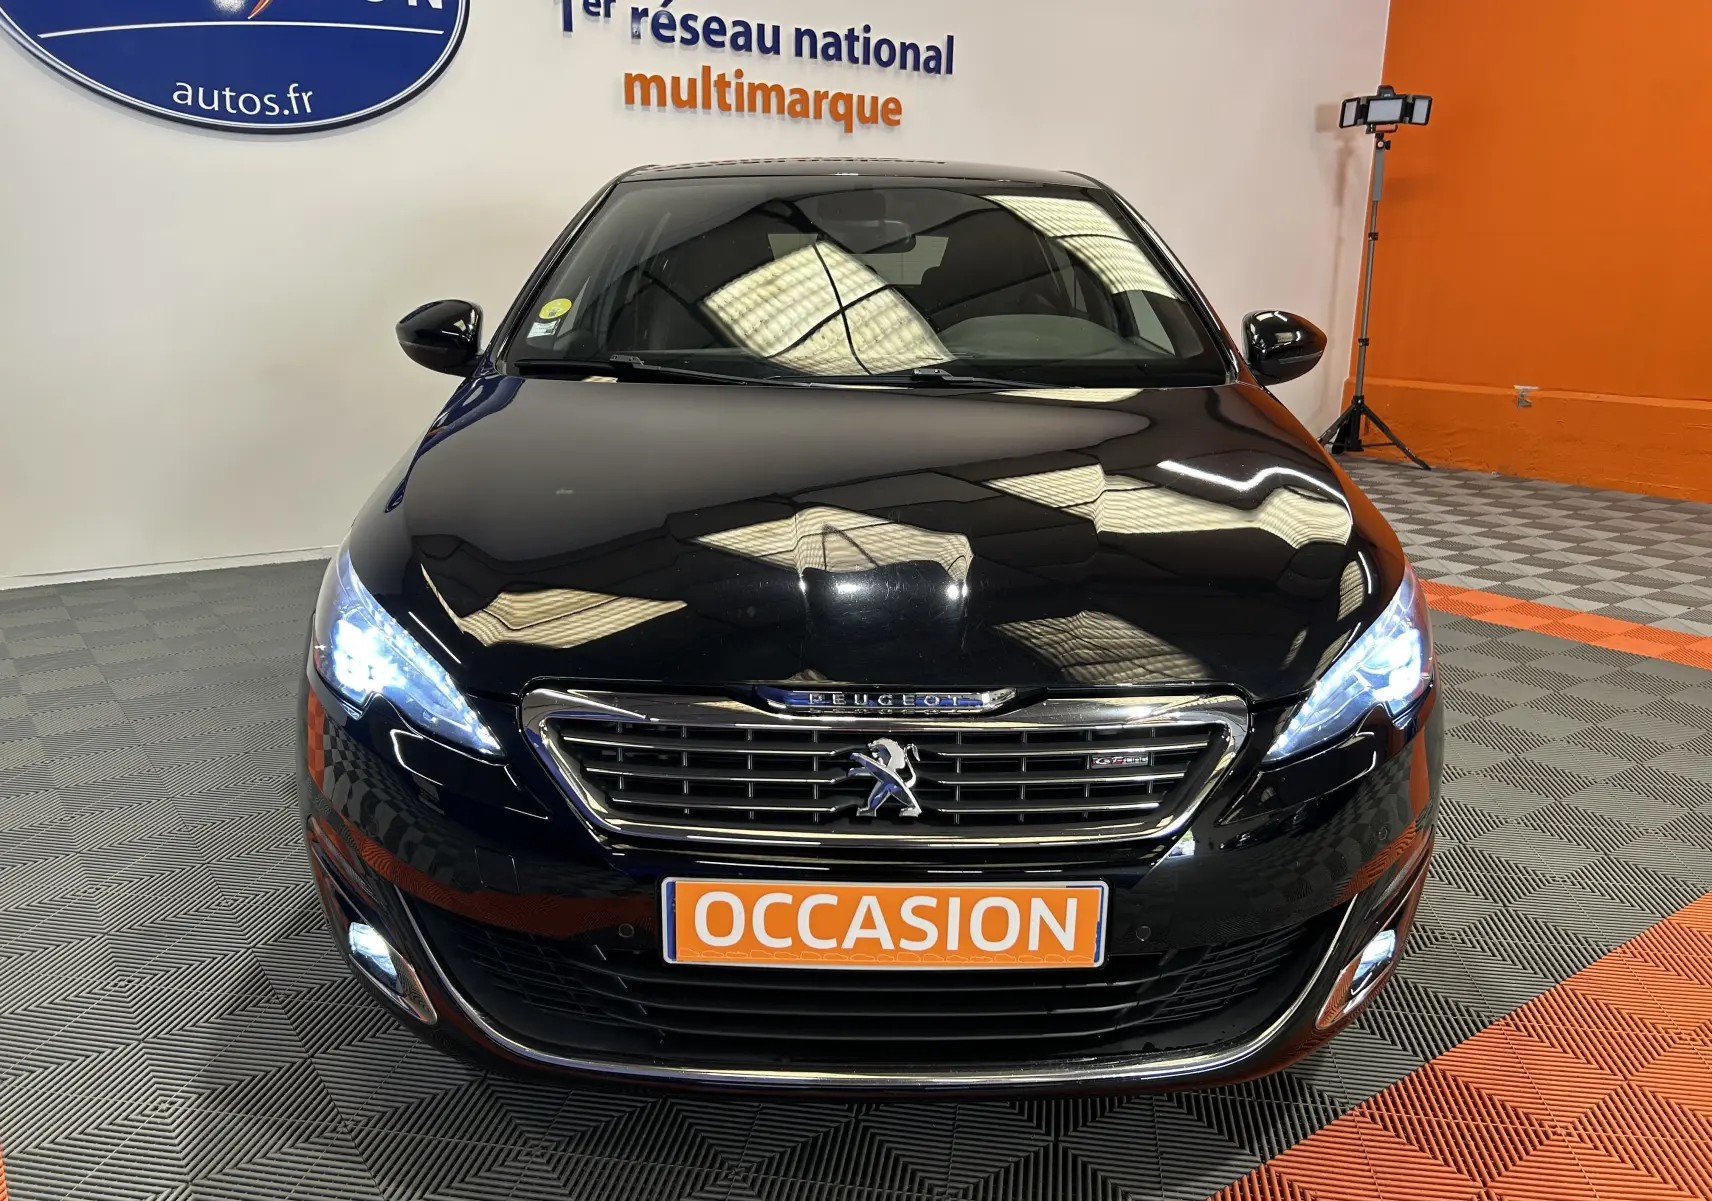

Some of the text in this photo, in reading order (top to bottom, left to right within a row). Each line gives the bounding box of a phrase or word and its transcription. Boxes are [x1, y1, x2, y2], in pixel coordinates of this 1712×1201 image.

[631, 0, 780, 56] réseau
[795, 25, 954, 75] national
[172, 81, 313, 116] autos.fr
[624, 65, 903, 133] multimarque
[809, 693, 961, 706] PEUGEOT
[694, 891, 1078, 952] OCCASION
